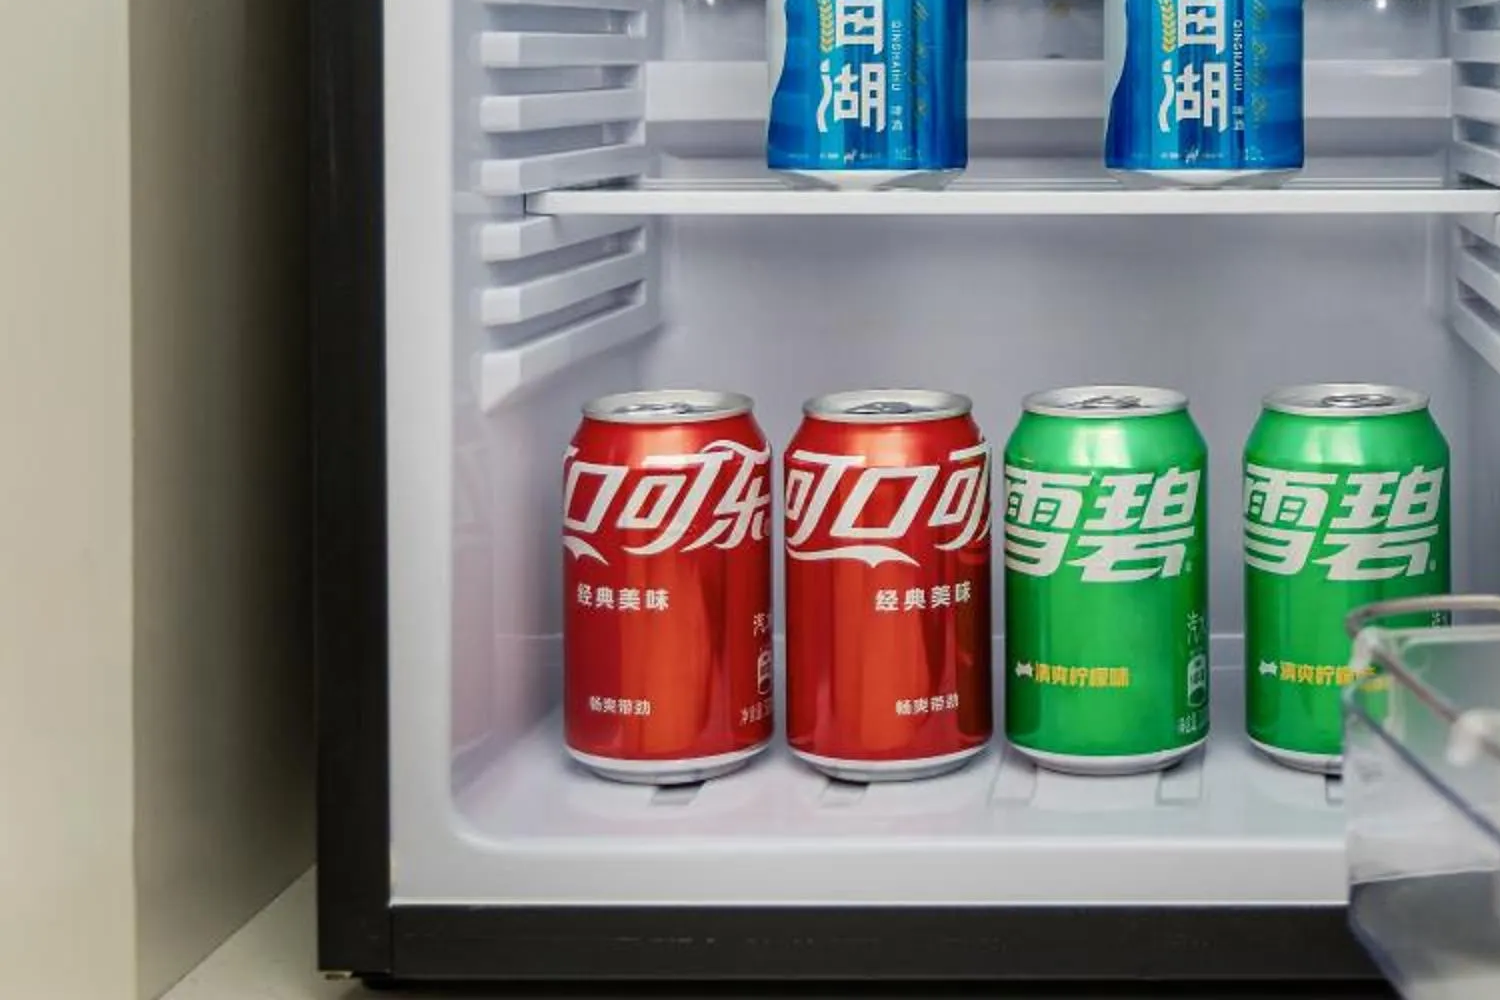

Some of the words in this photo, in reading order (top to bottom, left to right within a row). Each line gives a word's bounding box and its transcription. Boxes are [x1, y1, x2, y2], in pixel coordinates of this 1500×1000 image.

[563, 440, 772, 556] 口可乐
[785, 440, 992, 552] 可口可
[1004, 465, 1201, 583] 雪碧
[1245, 463, 1445, 581] 雪碧
[576, 582, 670, 612] 经典美味
[874, 580, 972, 612] 经典美味
[589, 695, 652, 717] 畅爽带劲
[895, 692, 959, 716] 畅爽带劲
